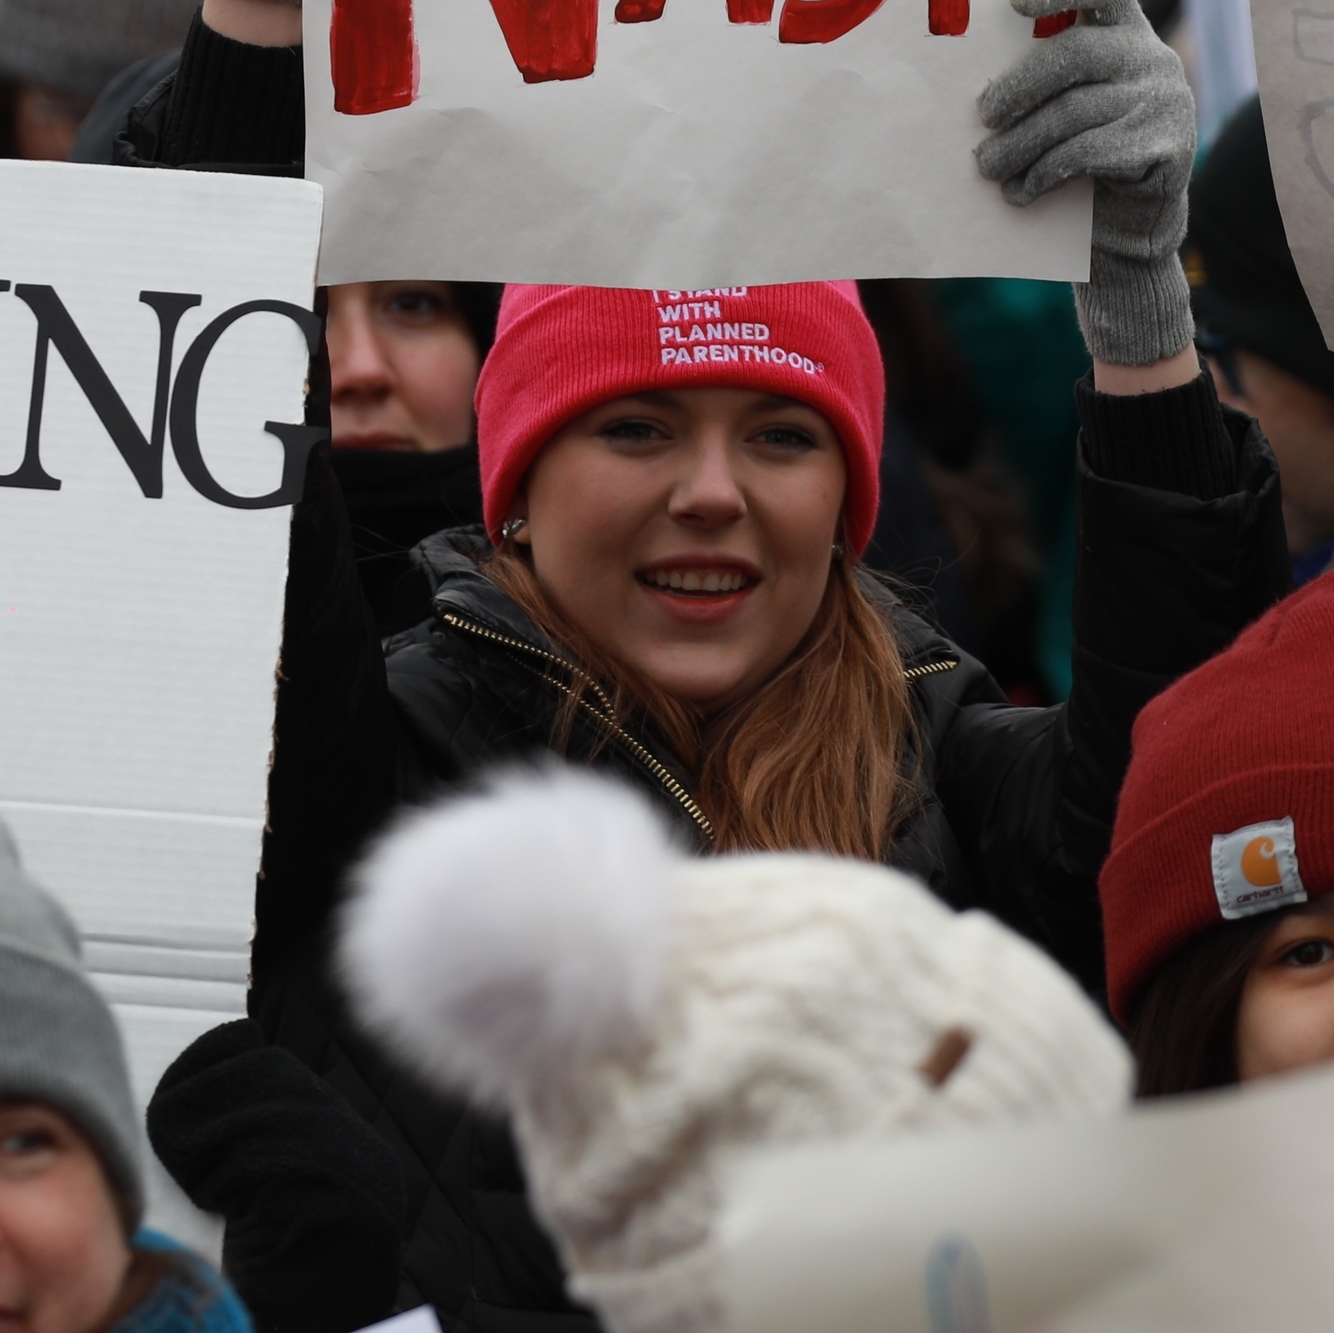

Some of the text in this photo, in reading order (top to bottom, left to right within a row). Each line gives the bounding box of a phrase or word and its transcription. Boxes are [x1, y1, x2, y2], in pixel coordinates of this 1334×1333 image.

[657, 300, 721, 323] WITH
[658, 322, 770, 345] PLANNED
[1236, 885, 1284, 903] carhartt
